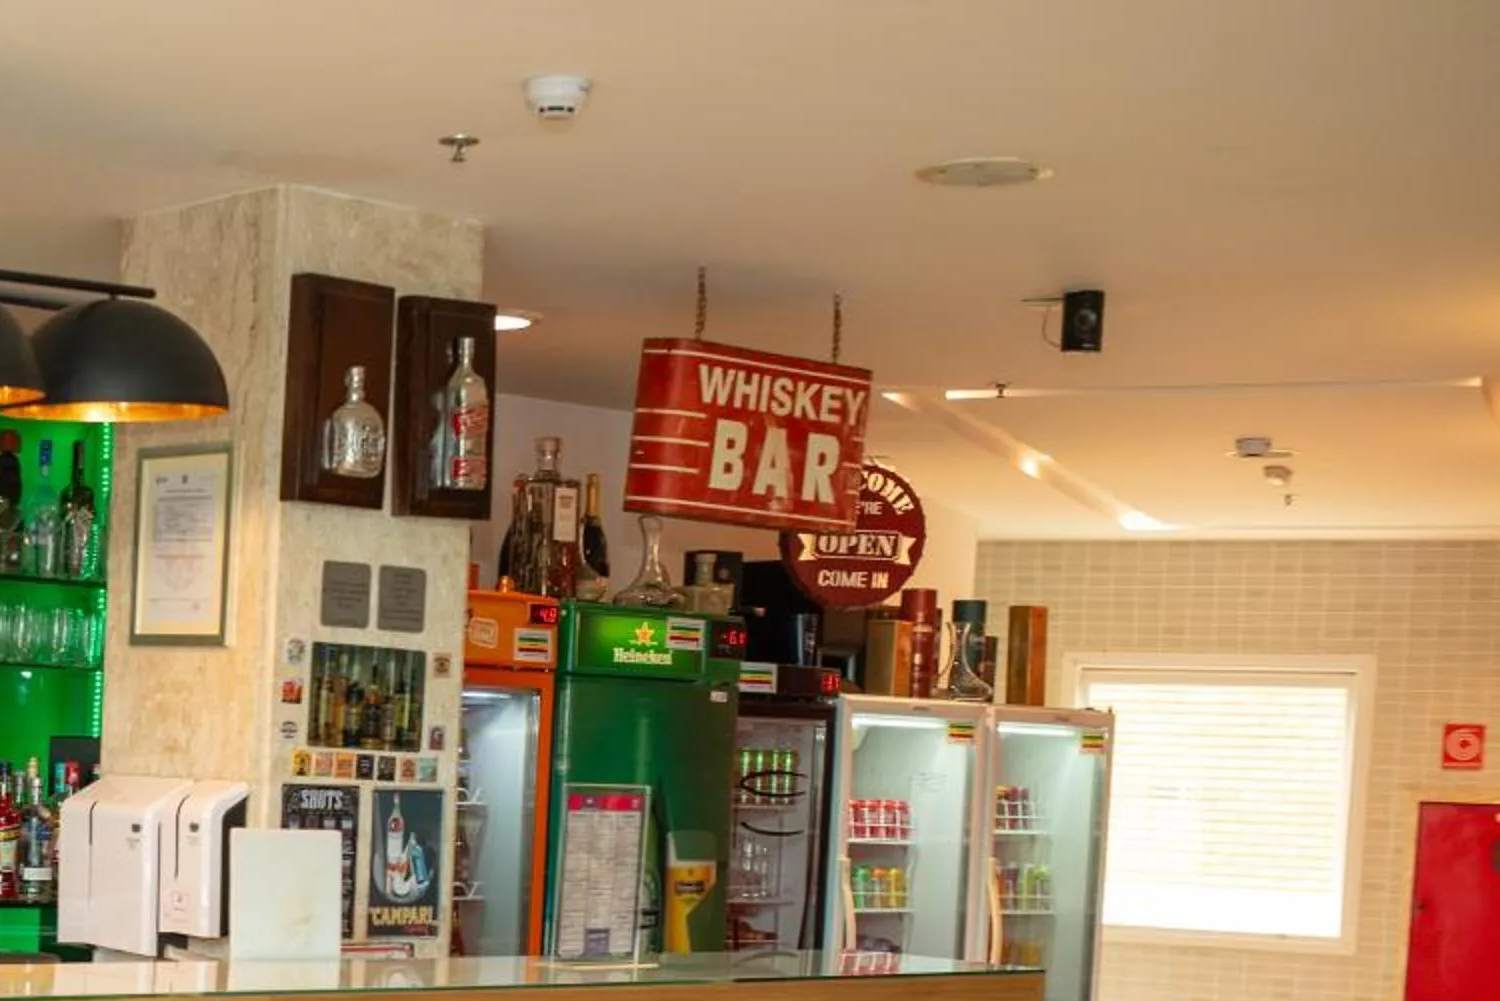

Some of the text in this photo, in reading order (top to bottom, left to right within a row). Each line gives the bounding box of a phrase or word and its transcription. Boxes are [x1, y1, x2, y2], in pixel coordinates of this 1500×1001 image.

[699, 364, 866, 427] WHISKEY
[708, 418, 841, 505] BAR
[817, 533, 896, 557] OPEN
[817, 568, 889, 589] COME IN
[613, 647, 672, 665] Heineken
